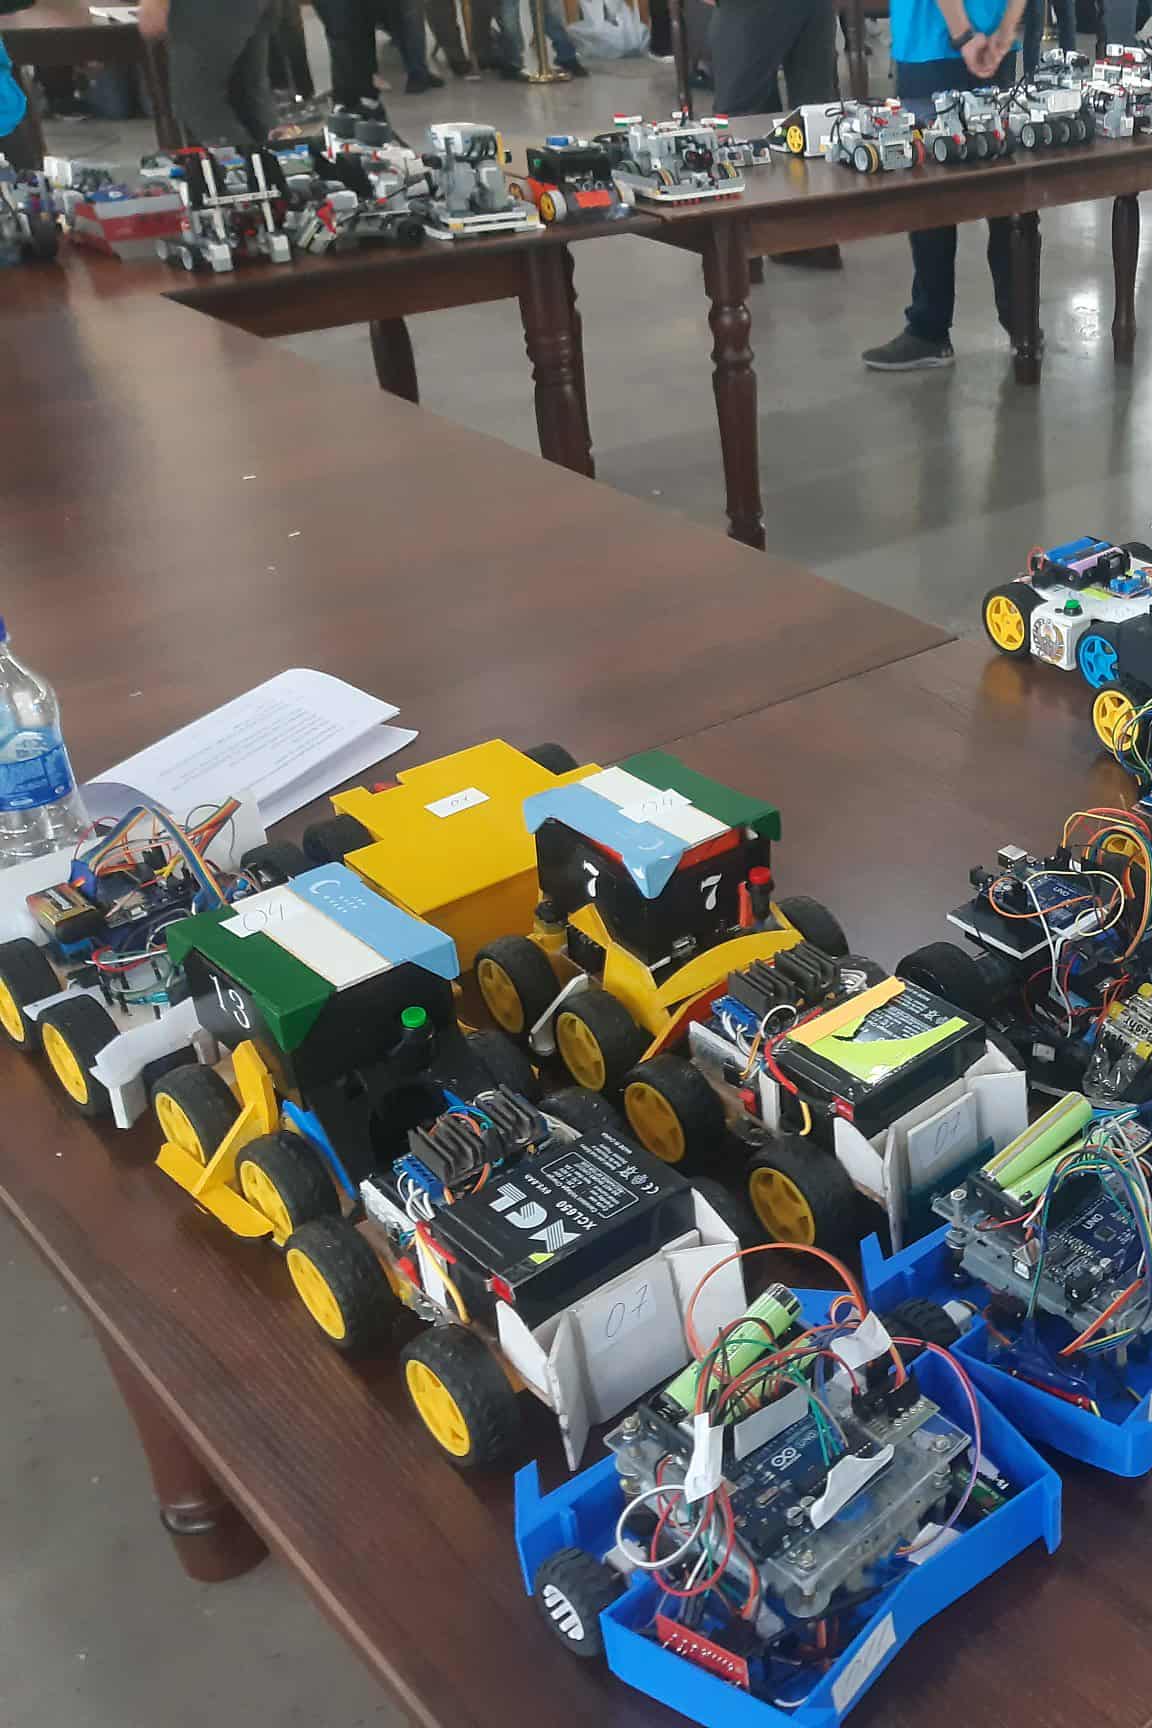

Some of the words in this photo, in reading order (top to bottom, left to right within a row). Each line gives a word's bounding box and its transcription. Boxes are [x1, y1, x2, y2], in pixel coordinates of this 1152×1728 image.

[700, 873, 722, 910] 7
[488, 1182, 582, 1253] XCL
[554, 1199, 598, 1231] XCL650
[606, 1284, 649, 1338] 07
